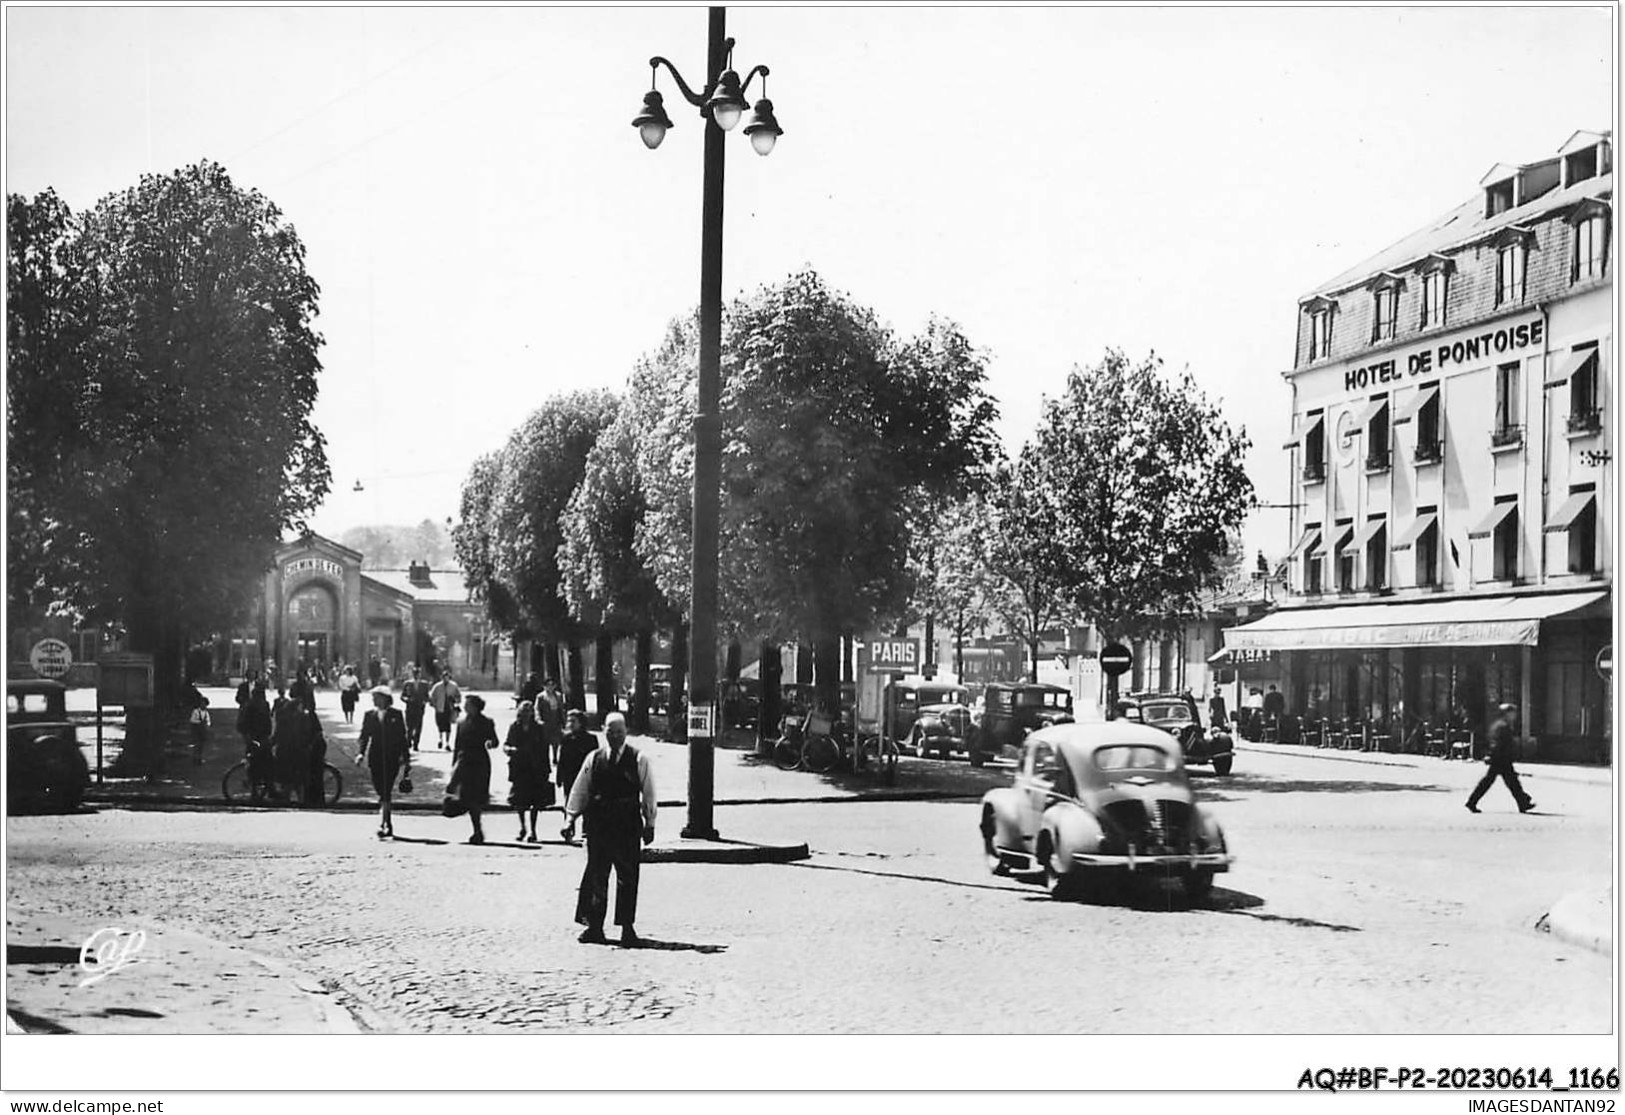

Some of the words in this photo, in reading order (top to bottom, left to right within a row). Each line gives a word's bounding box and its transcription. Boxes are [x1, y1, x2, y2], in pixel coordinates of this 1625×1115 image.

[1345, 359, 1402, 391] HOTEL
[1408, 350, 1432, 377] DE
[1439, 319, 1543, 368] PONTOISE
[871, 641, 915, 662] PARIS
